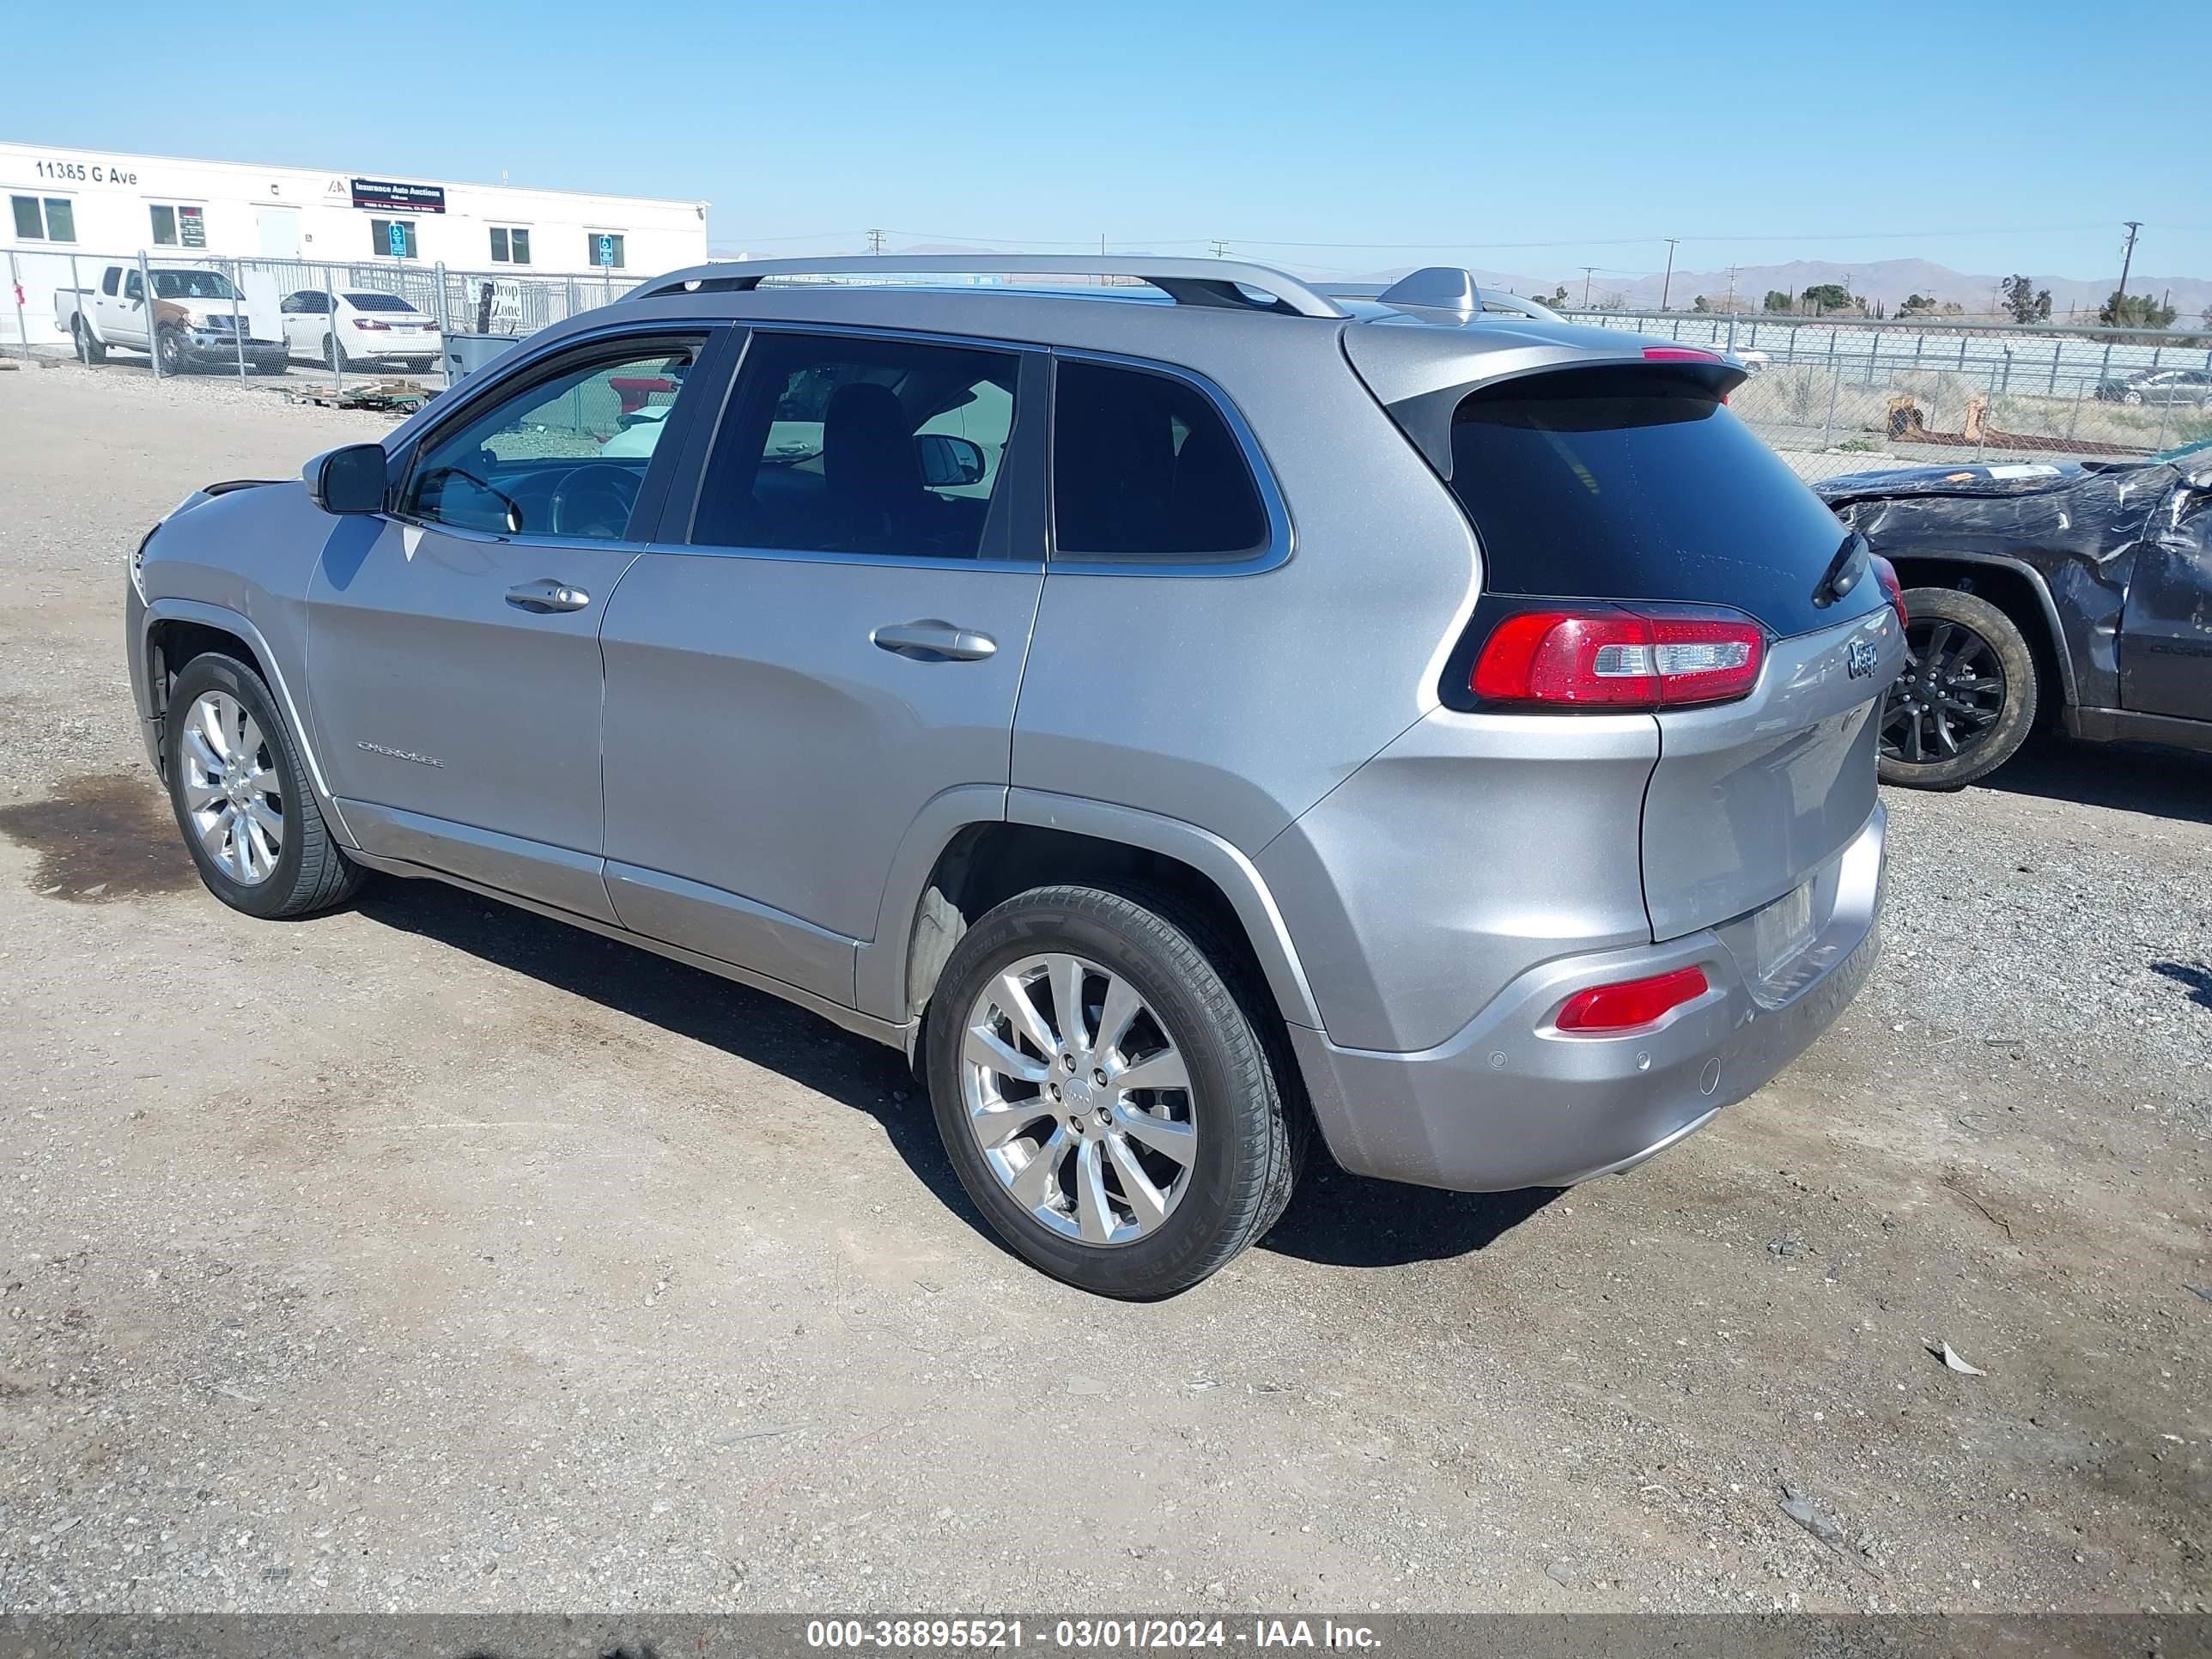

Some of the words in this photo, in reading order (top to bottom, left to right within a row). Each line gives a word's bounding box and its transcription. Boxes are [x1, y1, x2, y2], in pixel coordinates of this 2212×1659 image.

[36, 161, 85, 181] 11385
[92, 167, 103, 182] G
[110, 167, 137, 185] Ave
[356, 182, 392, 193] Insurance
[392, 185, 409, 195] Auto
[410, 187, 441, 198] Auctions
[492, 281, 518, 301] Drop
[493, 300, 520, 317] Zone
